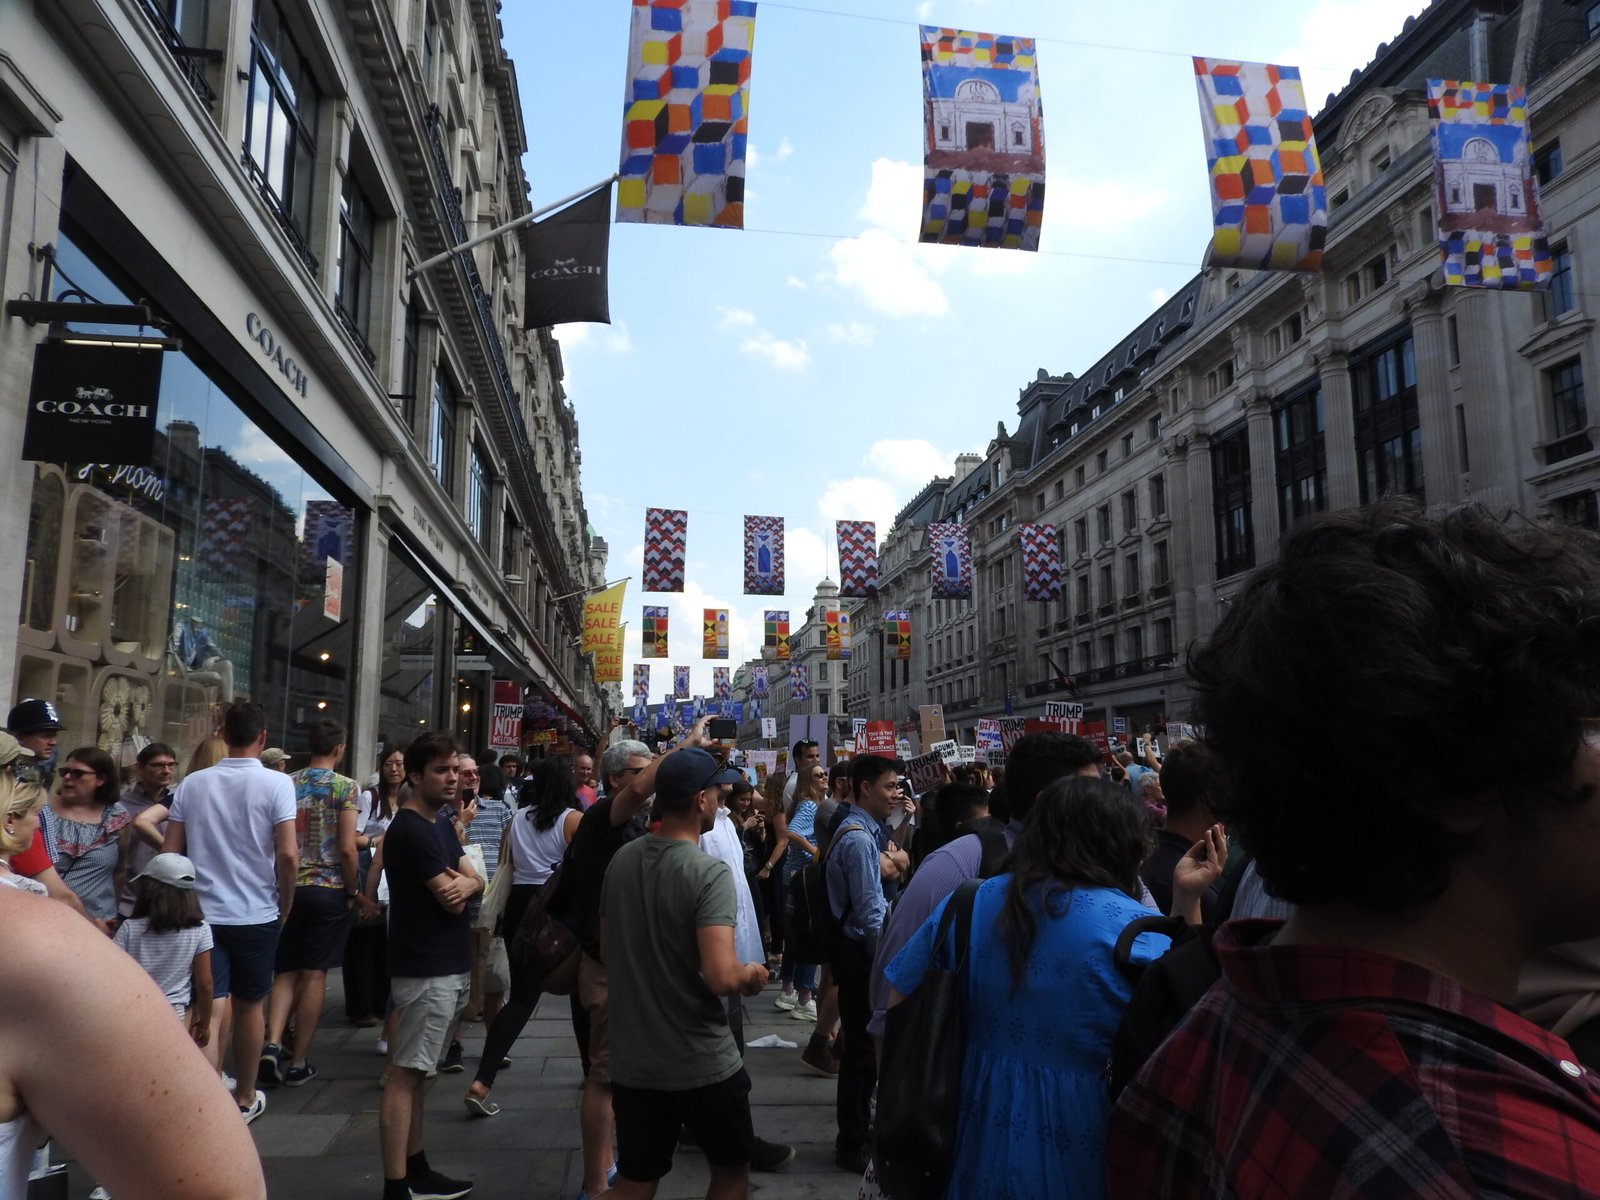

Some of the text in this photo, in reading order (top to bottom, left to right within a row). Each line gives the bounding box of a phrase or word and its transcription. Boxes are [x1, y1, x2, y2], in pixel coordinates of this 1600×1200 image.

[531, 266, 602, 279] COACH
[246, 312, 308, 400] COACH
[35, 399, 149, 418] COACH
[586, 602, 619, 614] SALE
[585, 617, 617, 630] SALE
[584, 632, 615, 647] SALE
[596, 656, 621, 665] SALE
[596, 668, 620, 678] SALE
[495, 705, 523, 718] TRUMP
[1048, 703, 1082, 718] TRUMP
[494, 717, 521, 737] NOT
[998, 718, 1025, 732] TRUMP
[492, 735, 519, 745] WELCOME
[977, 740, 991, 749] OFF
[906, 752, 941, 771] TRUMP
[910, 761, 942, 785] NOT
